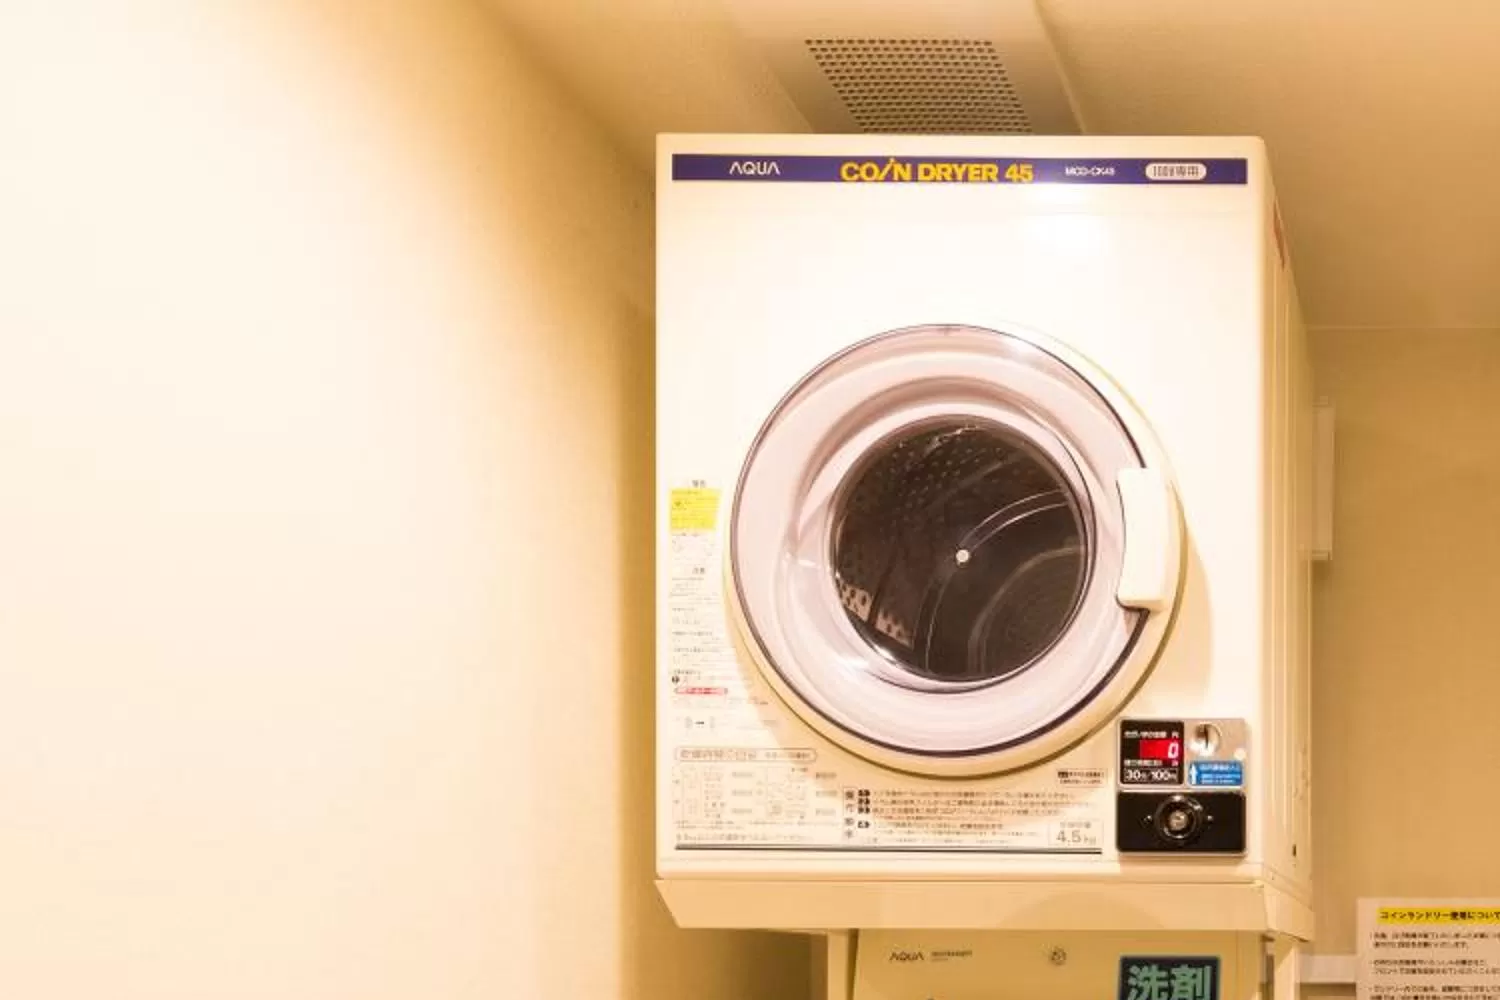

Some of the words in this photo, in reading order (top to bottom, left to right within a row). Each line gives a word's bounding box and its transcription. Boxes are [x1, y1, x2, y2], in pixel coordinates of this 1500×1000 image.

[729, 161, 781, 175] AQUA
[917, 162, 999, 182] DRYER
[1004, 163, 1034, 183] 45
[1168, 742, 1179, 759] 0
[889, 950, 924, 962] AQUA
